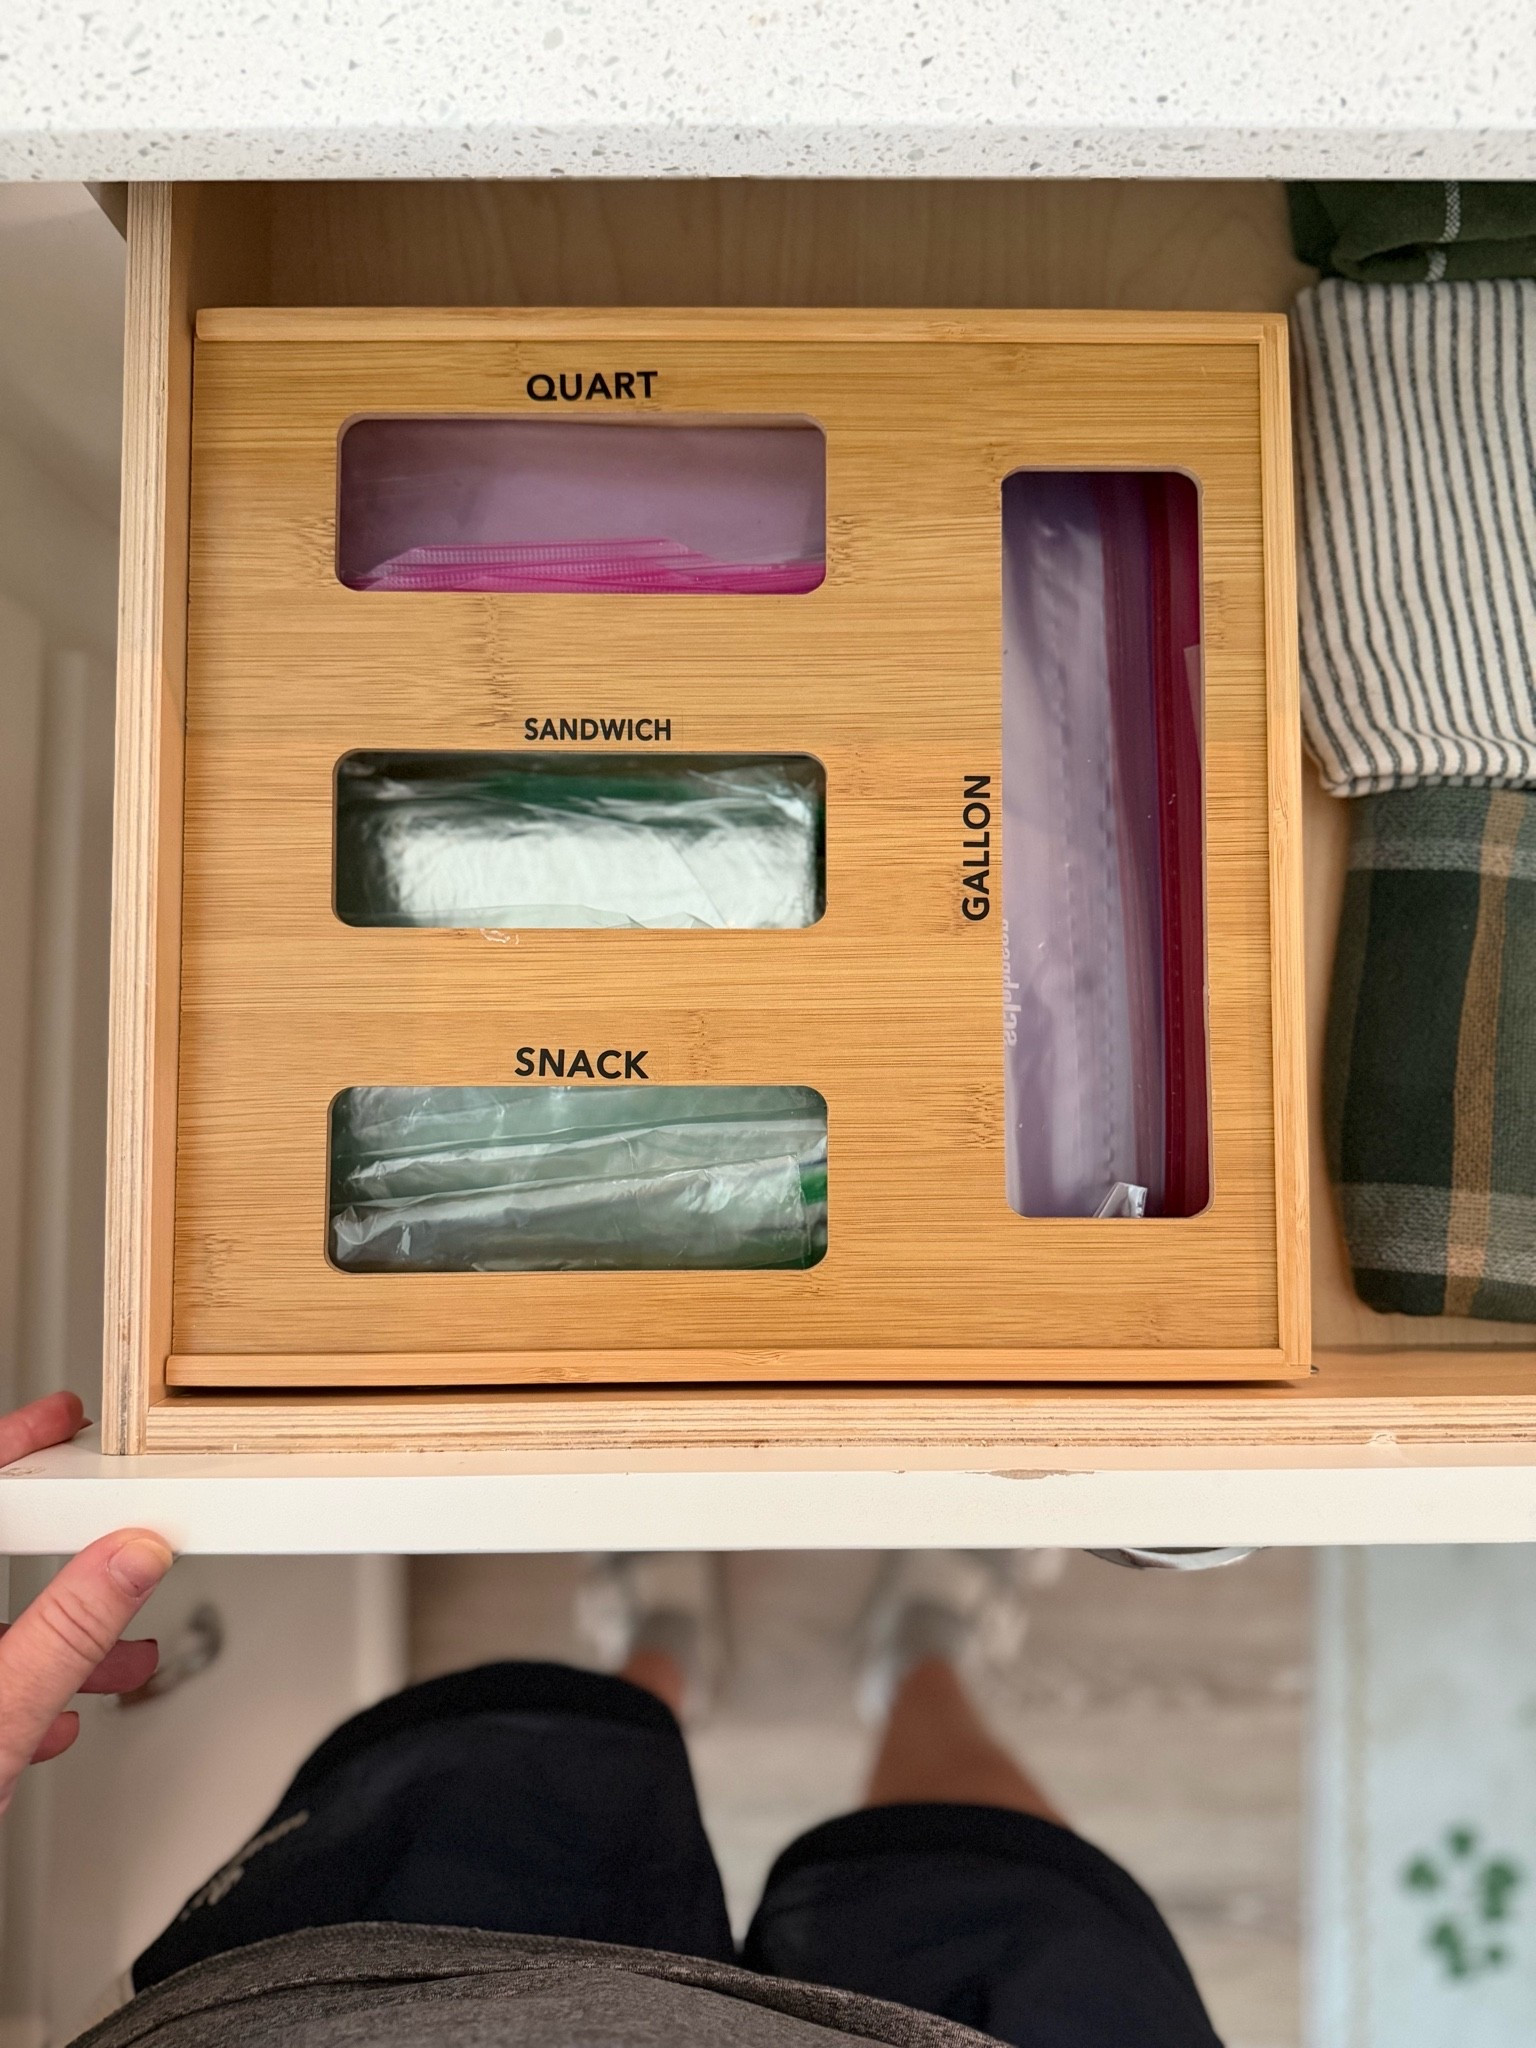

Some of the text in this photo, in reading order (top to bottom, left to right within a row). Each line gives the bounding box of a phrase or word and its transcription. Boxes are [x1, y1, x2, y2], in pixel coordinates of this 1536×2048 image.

[526, 370, 659, 402] QUART
[524, 717, 671, 742] SANDWICH
[962, 775, 991, 921] GALLON
[514, 1046, 649, 1080] SNACK
